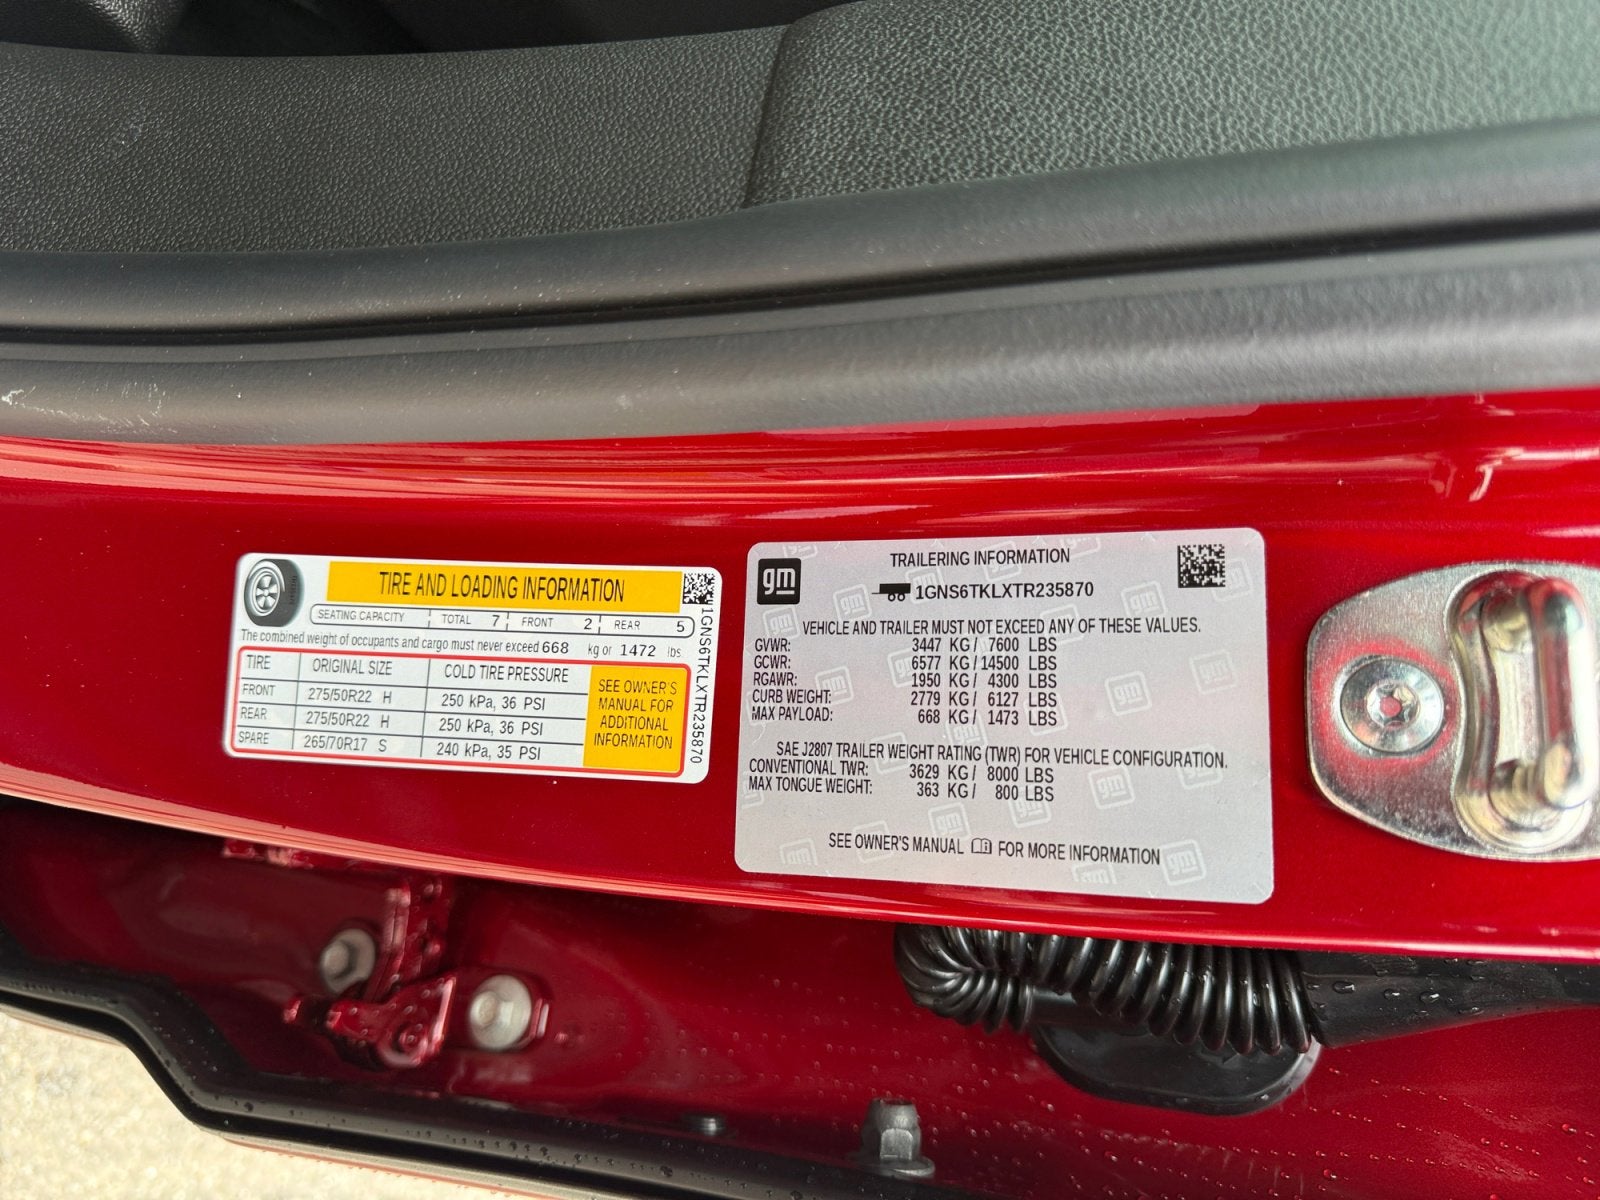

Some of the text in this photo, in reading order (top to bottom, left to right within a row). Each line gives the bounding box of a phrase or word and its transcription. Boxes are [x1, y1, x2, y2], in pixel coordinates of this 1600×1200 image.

[890, 548, 1071, 567] TRAILERING INFORMATION
[379, 571, 625, 602] TIRE AND LOADING INFORMATION
[762, 567, 796, 595] gm
[915, 581, 1094, 600] 1GNS6TKLXTR235870
[318, 609, 685, 633] SEATING CAPACITY TOTAL 7 FRONT 2 REAR 5
[803, 616, 1201, 636] VEHICLE AND TRAILER MUST NOT EXCEED ANY OF THESE VALUES.
[241, 629, 681, 658] The combined weight of occupants and cargo must never exceed 668 kg or 1472 lbs
[755, 637, 791, 652] GVWR:
[912, 637, 941, 652] 3447
[988, 637, 1019, 652] 7600
[1028, 637, 1057, 652] LBS
[247, 654, 569, 683] TIRE ORIGINAL SIZE COLD TIRE PRESSURE
[754, 655, 791, 669] GCWR:
[911, 655, 941, 670] 6577
[1028, 655, 1057, 671] LBS
[598, 679, 677, 695] SEE OWNER'S
[690, 607, 714, 764] 1GNS6TKLXTR235870
[753, 672, 798, 687] RGAWR:
[911, 673, 941, 688] 1950
[987, 673, 1019, 688] 4300
[1028, 673, 1057, 689] LBS
[242, 683, 546, 711] FRONT 275/50R22 H 250 kPa, 36 PSI
[598, 697, 674, 713] MANUAL FOR
[752, 689, 783, 704] CURB
[786, 689, 831, 705] WEIGHT:
[910, 691, 941, 706] 2779
[987, 692, 1019, 707] 6127
[1028, 692, 1057, 707] LBS
[240, 706, 543, 736] REAR 275/50R22 H 250 kPa, 36 PSI
[600, 714, 669, 731] ADDITIONAL
[752, 706, 776, 721] MAX
[778, 706, 833, 722] PAYLOAD:
[918, 709, 941, 724] 668
[987, 710, 1019, 726] 1473
[1028, 710, 1057, 726] LBS
[238, 730, 541, 761] SPARE 265/70R17 S 240 kPa, 35 PSI
[594, 732, 673, 749] INFORMATION
[776, 741, 1228, 769] SAE J2807 TRAILER WEIGHT RATING (TWR) FOR VEHICLE CONFIGURATION.
[749, 758, 836, 776] CONVENTIONAL
[840, 760, 869, 776] TWR:
[909, 763, 939, 780] 3629
[987, 766, 1019, 782] 8000
[1025, 767, 1054, 784] LBS
[749, 776, 773, 791] MAX
[776, 776, 823, 793] TONGUE
[825, 778, 872, 795] WEIGHT:
[917, 781, 939, 798] 363
[995, 784, 1019, 801] 800
[1025, 785, 1054, 802] LBS
[829, 832, 1160, 866] SEE OWNER'S MANUAL FOR MORE INFORMATION
